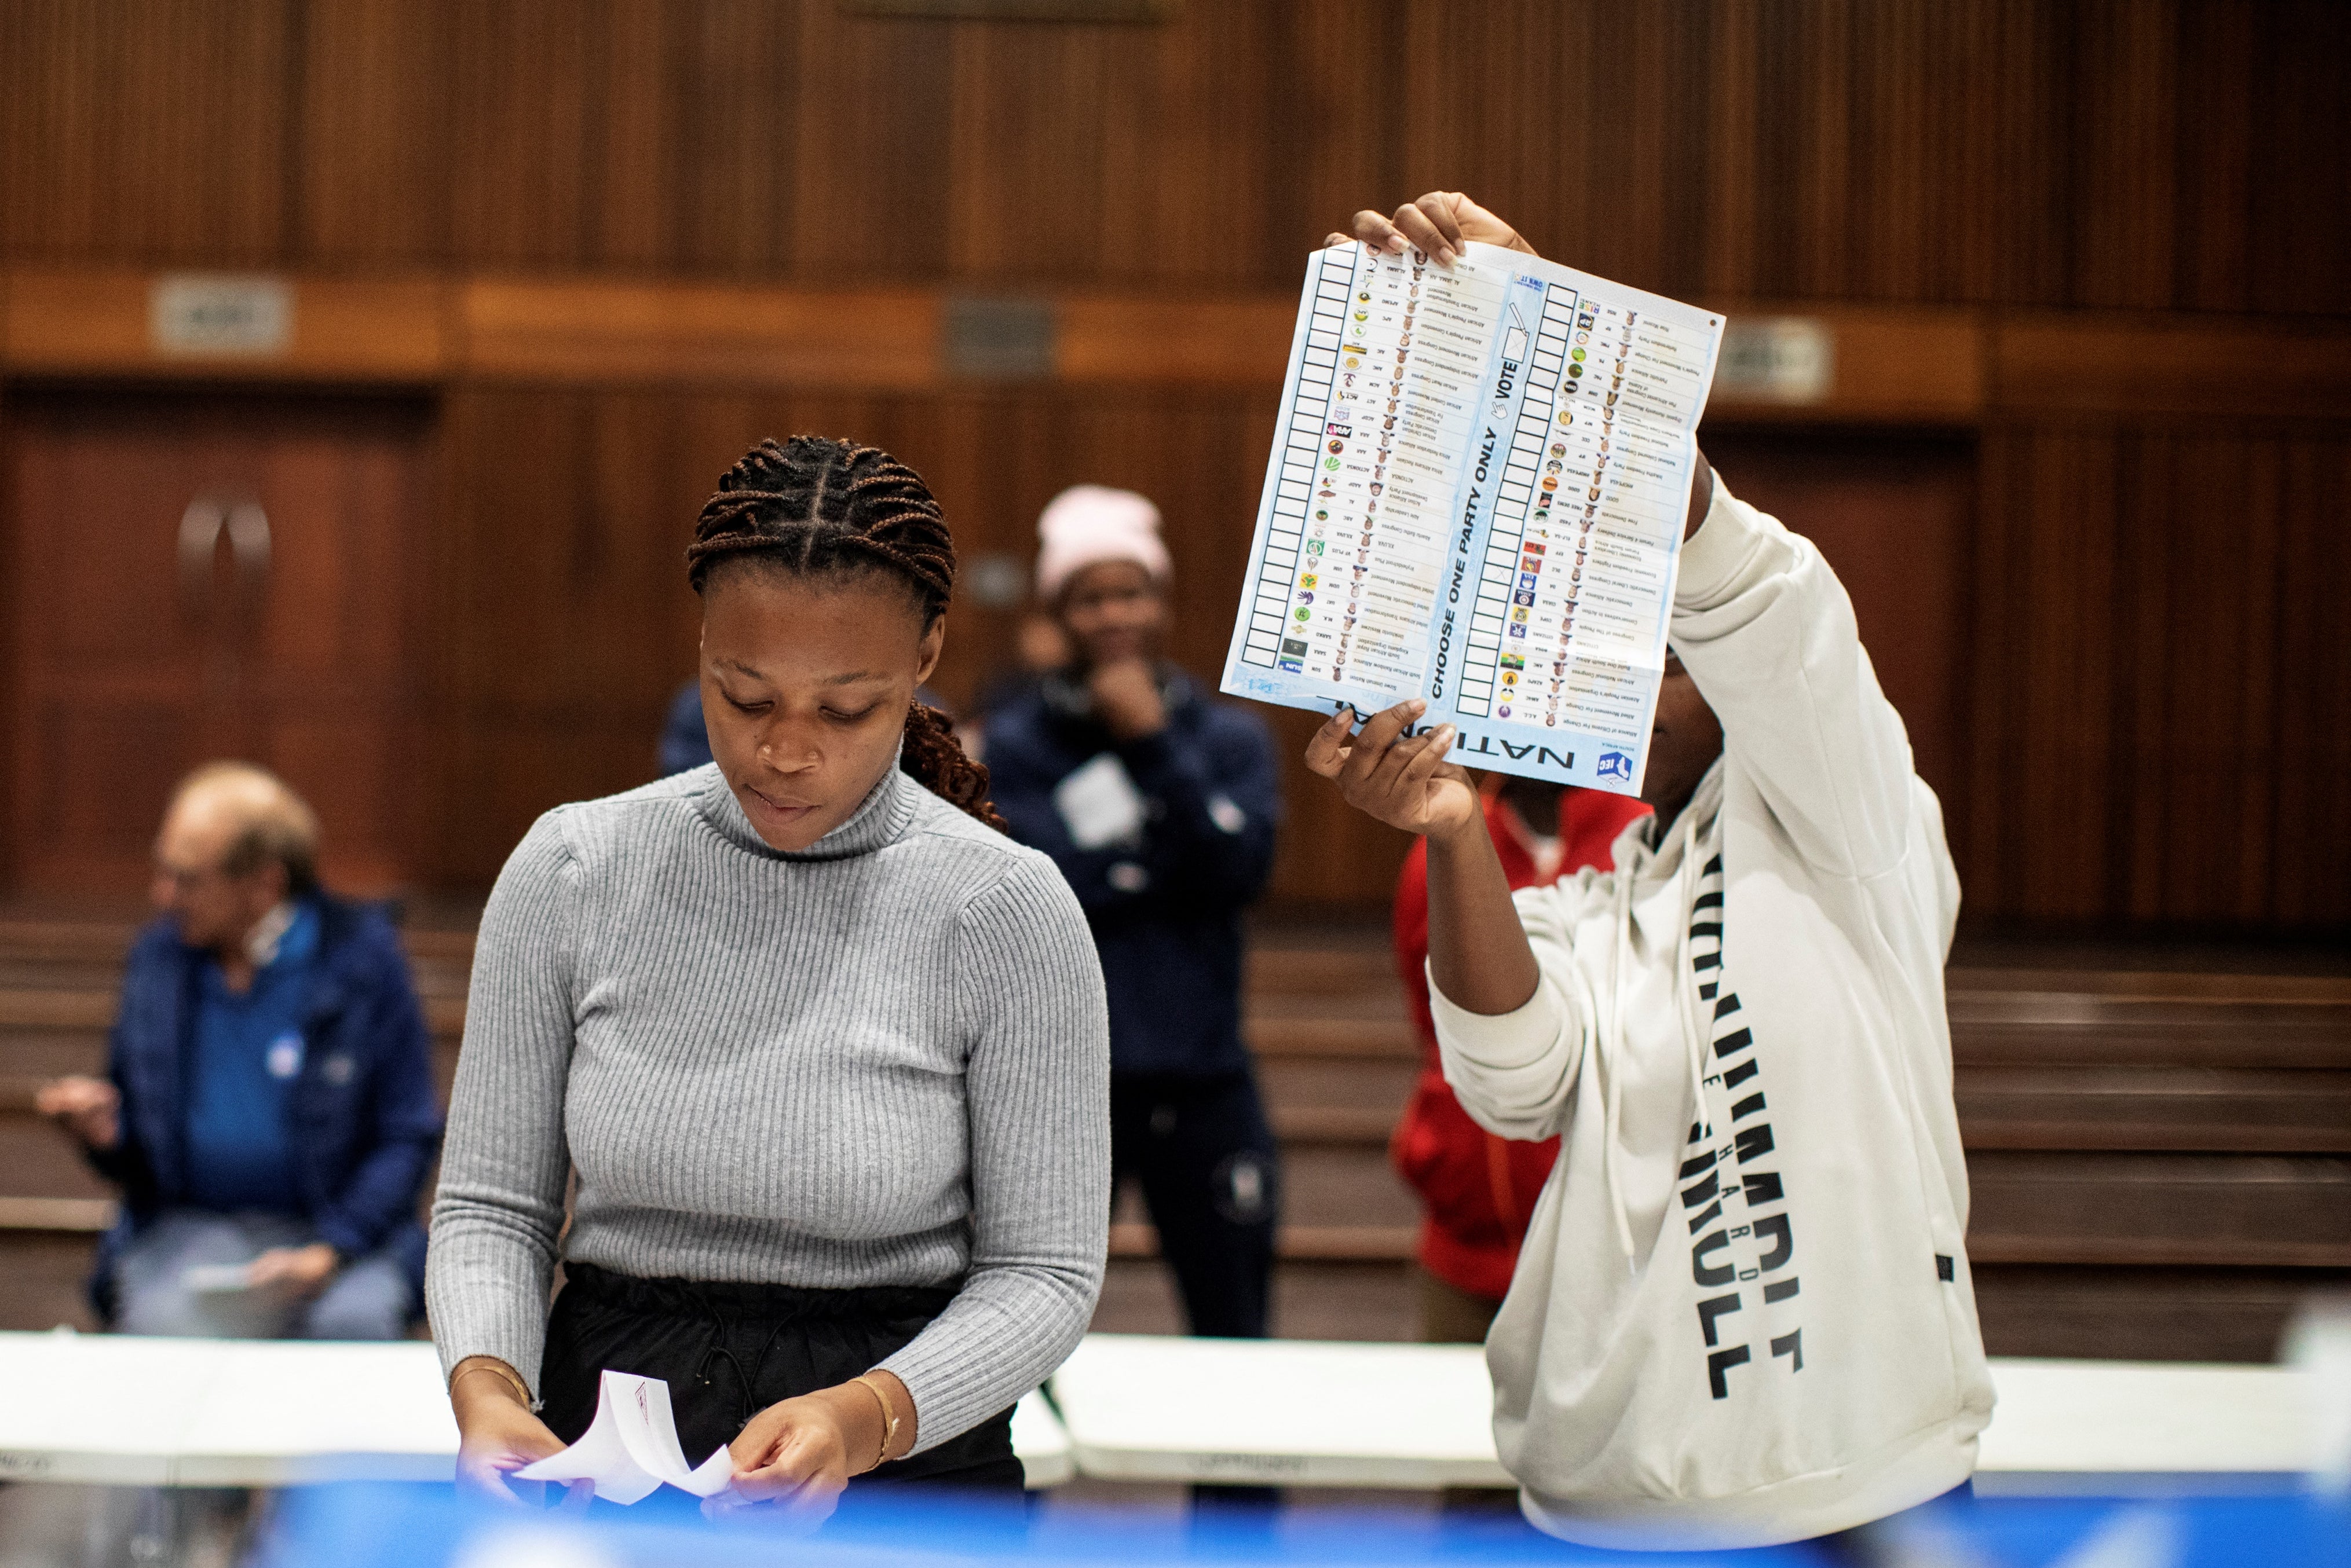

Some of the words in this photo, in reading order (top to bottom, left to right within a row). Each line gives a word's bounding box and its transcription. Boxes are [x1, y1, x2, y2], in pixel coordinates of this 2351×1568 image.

[1529, 277, 1544, 288] OWN
[1427, 287, 1451, 296] Movement
[1381, 298, 1398, 306] APEMO
[1426, 293, 1460, 306] Transformation
[1424, 306, 1447, 317] Movement
[1460, 303, 1478, 311] African
[1578, 302, 1600, 313] RISE
[1447, 313, 1467, 322] People's
[1467, 318, 1484, 327] African
[1420, 323, 1445, 334] Convention
[1445, 330, 1464, 339] People's
[1417, 339, 1438, 349] Congress
[1464, 336, 1482, 344] African
[1438, 346, 1460, 356] Movement
[1414, 356, 1435, 365] Congress
[1460, 353, 1478, 361] African
[1434, 362, 1460, 373] Independent
[1410, 372, 1431, 382] Congress
[1460, 370, 1478, 379] African
[1496, 361, 1518, 399] VOTE
[1442, 382, 1457, 390] African
[1407, 390, 1430, 400] Movement
[1430, 397, 1446, 405] Content
[1446, 401, 1461, 409] African
[1405, 403, 1436, 415] Transformation
[1405, 409, 1425, 419] Congress
[1332, 425, 1351, 435] ARA
[1402, 426, 1422, 435] Christian
[1414, 423, 1437, 433] Democratic
[1346, 463, 1369, 472] ACTIONSA
[1391, 473, 1413, 483] ACTIONSA
[1388, 493, 1407, 502] Alliance
[1401, 490, 1428, 500] Development
[1384, 506, 1409, 516] Leadership
[1601, 511, 1626, 521] Democrats
[1381, 523, 1403, 533] Congress
[1336, 531, 1352, 539] XILUVA
[1377, 540, 1394, 548] XILUVA
[1385, 559, 1414, 570] Vryheidsfront
[1432, 607, 1456, 699] CHOOSE
[1449, 558, 1466, 604] ONE
[1460, 486, 1481, 555] PARTY
[1476, 426, 1497, 482] ONLY
[1585, 592, 1604, 600] Alliance
[1605, 596, 1632, 606] Democratic
[1361, 624, 1381, 633] Wesizwe
[1381, 629, 1403, 639] Umkhonto
[1357, 638, 1387, 649] Organization
[1370, 647, 1387, 655] African
[1387, 644, 1408, 654] Kingdoms
[1285, 662, 1301, 671] SUN
[1352, 658, 1372, 666] Alliance
[1373, 662, 1392, 671] Rainbow
[1571, 669, 1595, 677] Congress
[1593, 708, 1619, 716] Movement
[1599, 759, 1614, 771] IEC
[1718, 1144, 1760, 1282] HARD
